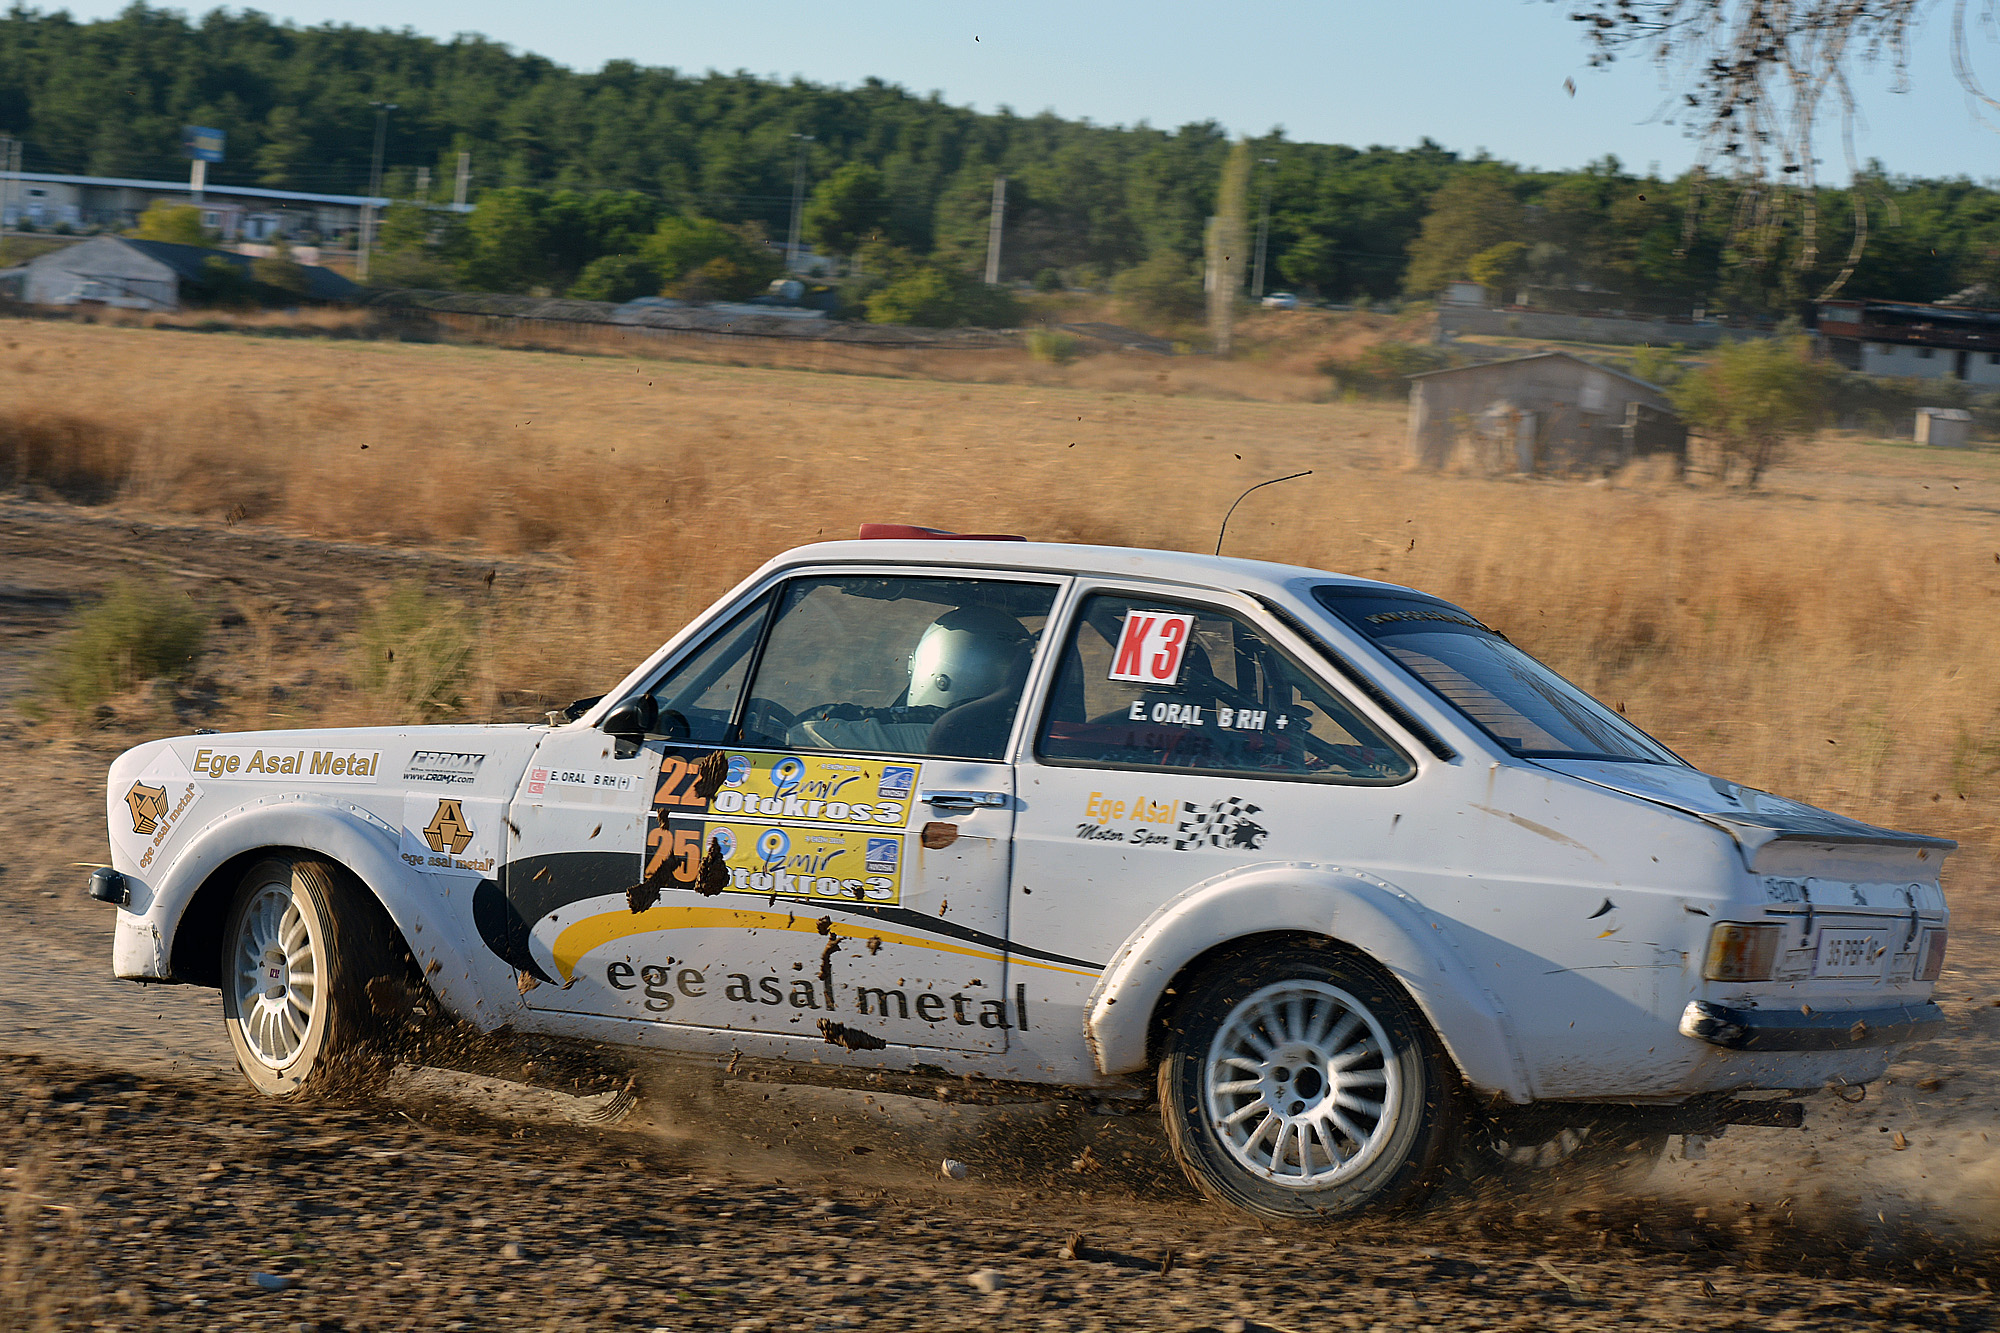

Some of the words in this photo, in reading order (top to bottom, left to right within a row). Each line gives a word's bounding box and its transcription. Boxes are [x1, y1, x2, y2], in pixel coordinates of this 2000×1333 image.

[1128, 700, 1148, 721] E.
[1151, 703, 1204, 726] ORAL
[193, 749, 241, 778] Ege
[246, 749, 304, 775] Asal
[309, 751, 380, 777] Metal
[561, 772, 586, 785] ORAL
[713, 789, 905, 824] Otokros3
[1085, 791, 1126, 825] Ege
[1128, 796, 1180, 825] Asal
[139, 846, 155, 869] ege
[152, 820, 171, 847] asal
[1075, 822, 1126, 842] Motor
[1129, 827, 1171, 847] Spor
[401, 852, 424, 867] ege
[427, 854, 452, 868] asal
[644, 827, 701, 883] 25
[726, 865, 895, 900] tokros3
[606, 960, 708, 1012] ege
[724, 966, 836, 1012] asal
[856, 982, 1031, 1032] metal
